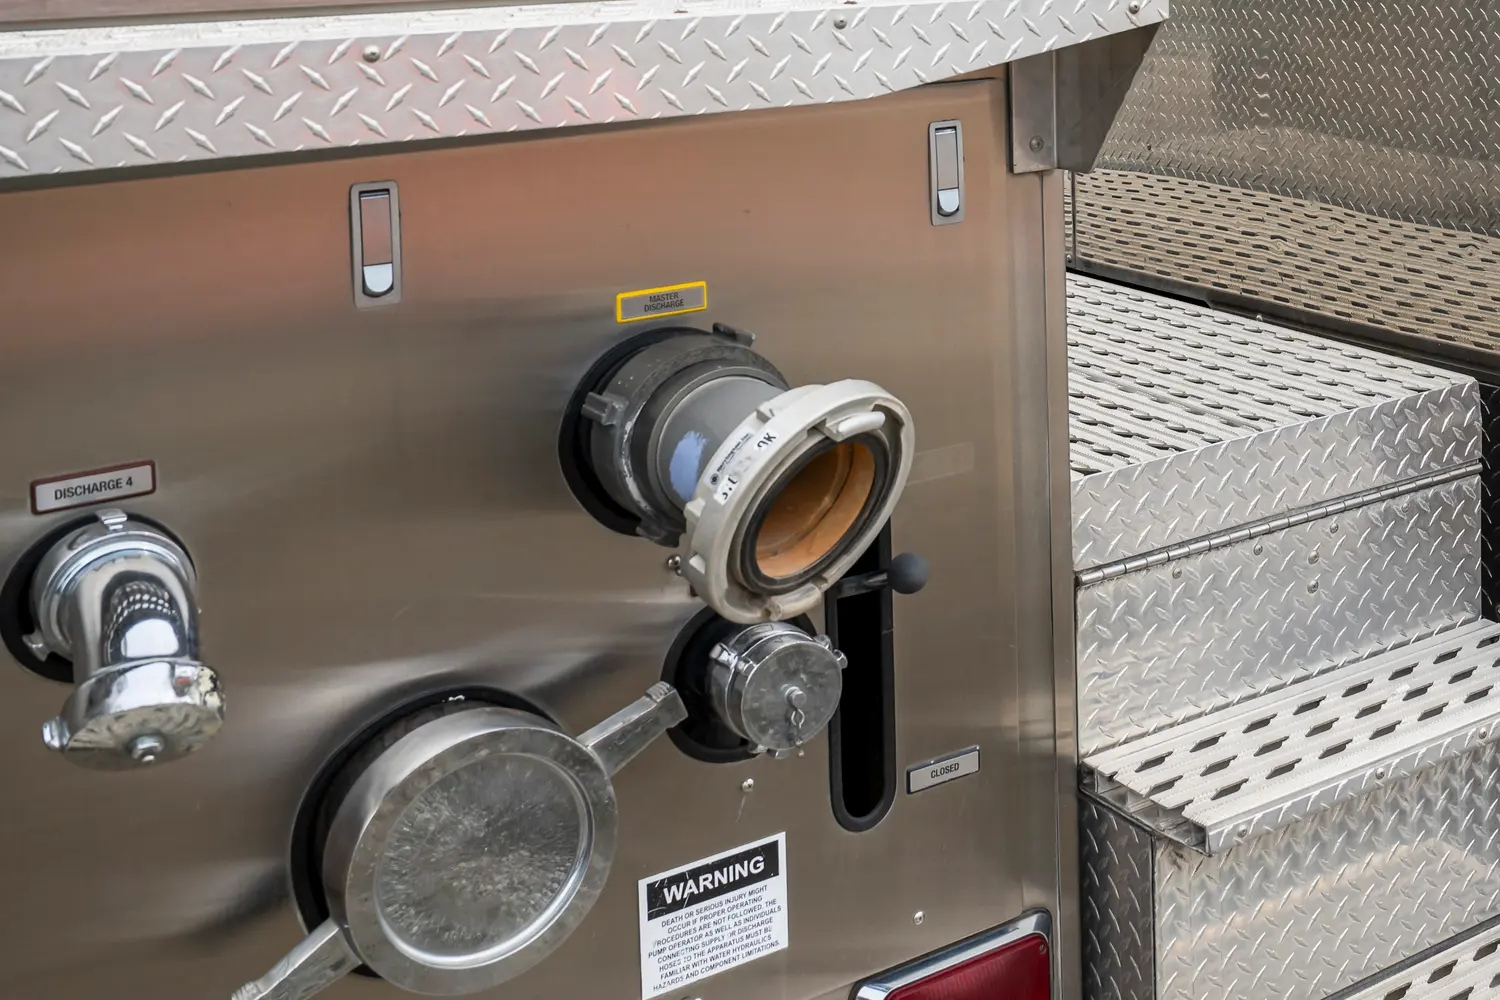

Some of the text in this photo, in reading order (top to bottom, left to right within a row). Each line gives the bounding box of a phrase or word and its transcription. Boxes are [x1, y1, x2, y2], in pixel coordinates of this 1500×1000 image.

[644, 299, 684, 312] DISCHARGE
[649, 291, 679, 303] MASTER
[54, 476, 133, 500] DISCHARGE 4
[930, 762, 960, 779] CLOSED
[663, 855, 766, 904] WARNING
[653, 926, 696, 948] ROCEDURES
[698, 921, 711, 931] ARE
[713, 916, 725, 926] NOT
[765, 898, 776, 907] THE
[661, 884, 767, 927] DEATH OR SERIOUS INJURY MIGHT
[667, 920, 690, 934] OCCUR
[699, 908, 725, 922] PROPER
[727, 895, 762, 913] OPERATING
[648, 905, 781, 958] PUMP OPERATOR AS WELL AS INDIVIDUALS
[657, 943, 699, 963] CONNECTING
[701, 934, 723, 947] SUPPLY
[737, 916, 772, 934] DISCHARGE
[694, 949, 705, 959] THE
[707, 935, 743, 954] APPARATUS
[745, 929, 761, 940] MUST
[653, 974, 683, 991] HAZARDS
[685, 969, 698, 979] AND
[700, 954, 739, 974] COMPONENT
[661, 934, 771, 980] FAMILIAR WITH WATER HYDRAULICS
